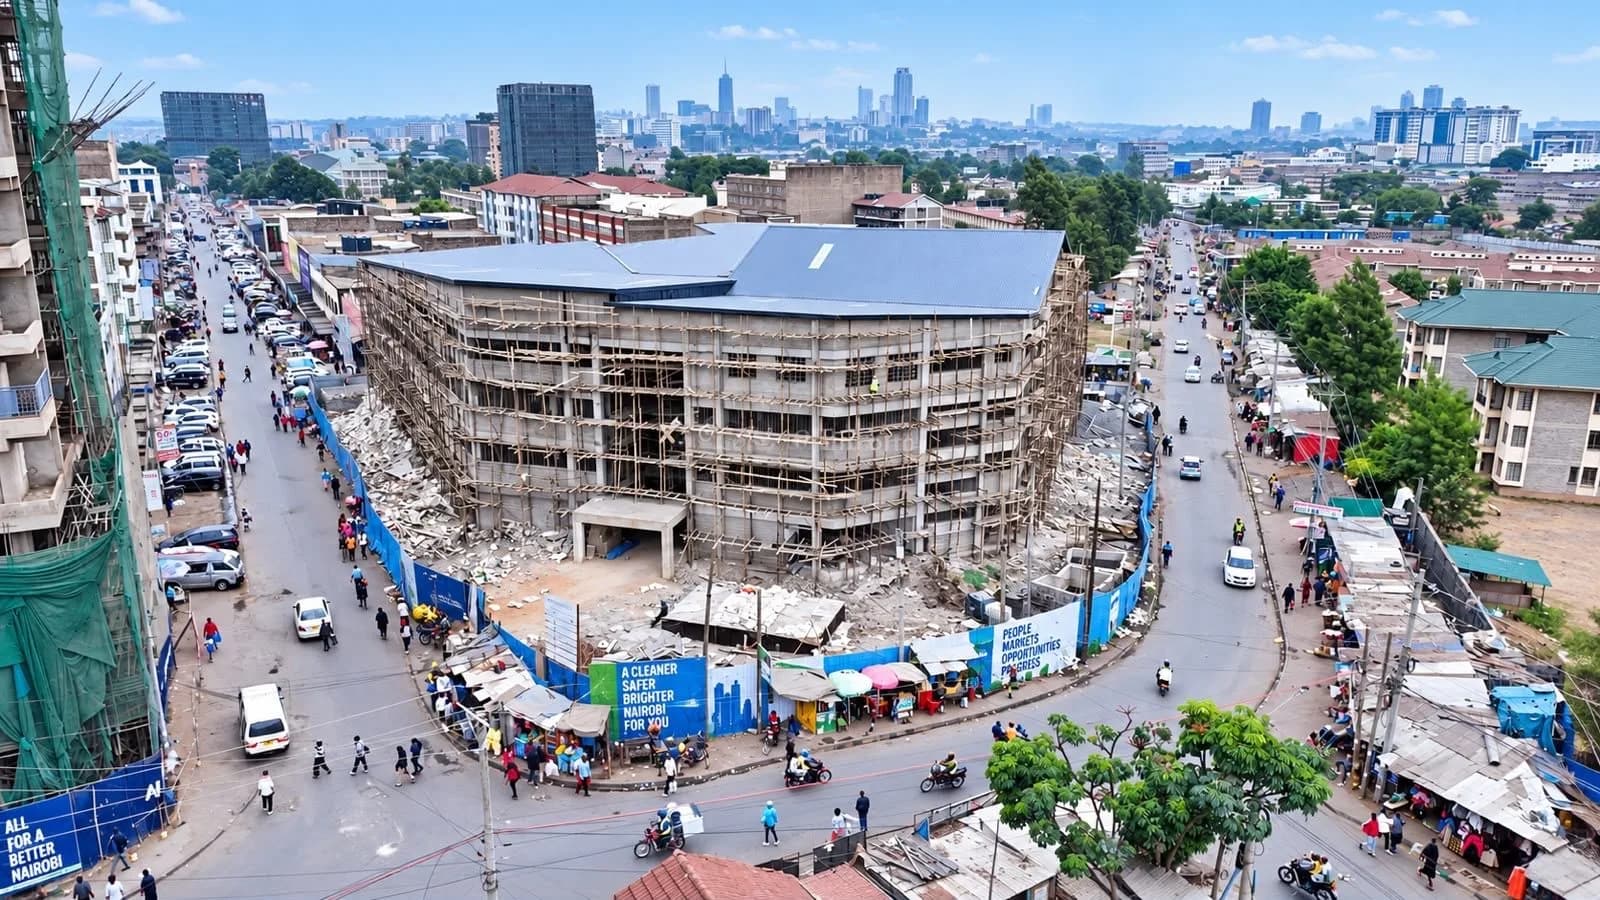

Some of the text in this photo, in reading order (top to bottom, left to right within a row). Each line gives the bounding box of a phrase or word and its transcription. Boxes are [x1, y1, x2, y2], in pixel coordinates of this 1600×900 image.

[1003, 623, 1032, 640] PEOPLE
[1001, 639, 1061, 664] OPPORTUNITIES
[1002, 633, 1039, 652] MARKETS
[622, 663, 678, 678] A CLEANER
[1001, 656, 1040, 676] PRGRESS
[622, 679, 656, 692] SAFER
[623, 690, 674, 705] BRIGHTER
[624, 703, 666, 718] NAIROBI
[624, 719, 645, 731] FOR
[5, 816, 29, 834] ALL
[7, 828, 45, 853] FOR A
[8, 842, 55, 867] BETTER
[11, 855, 63, 883] NAIROBI
